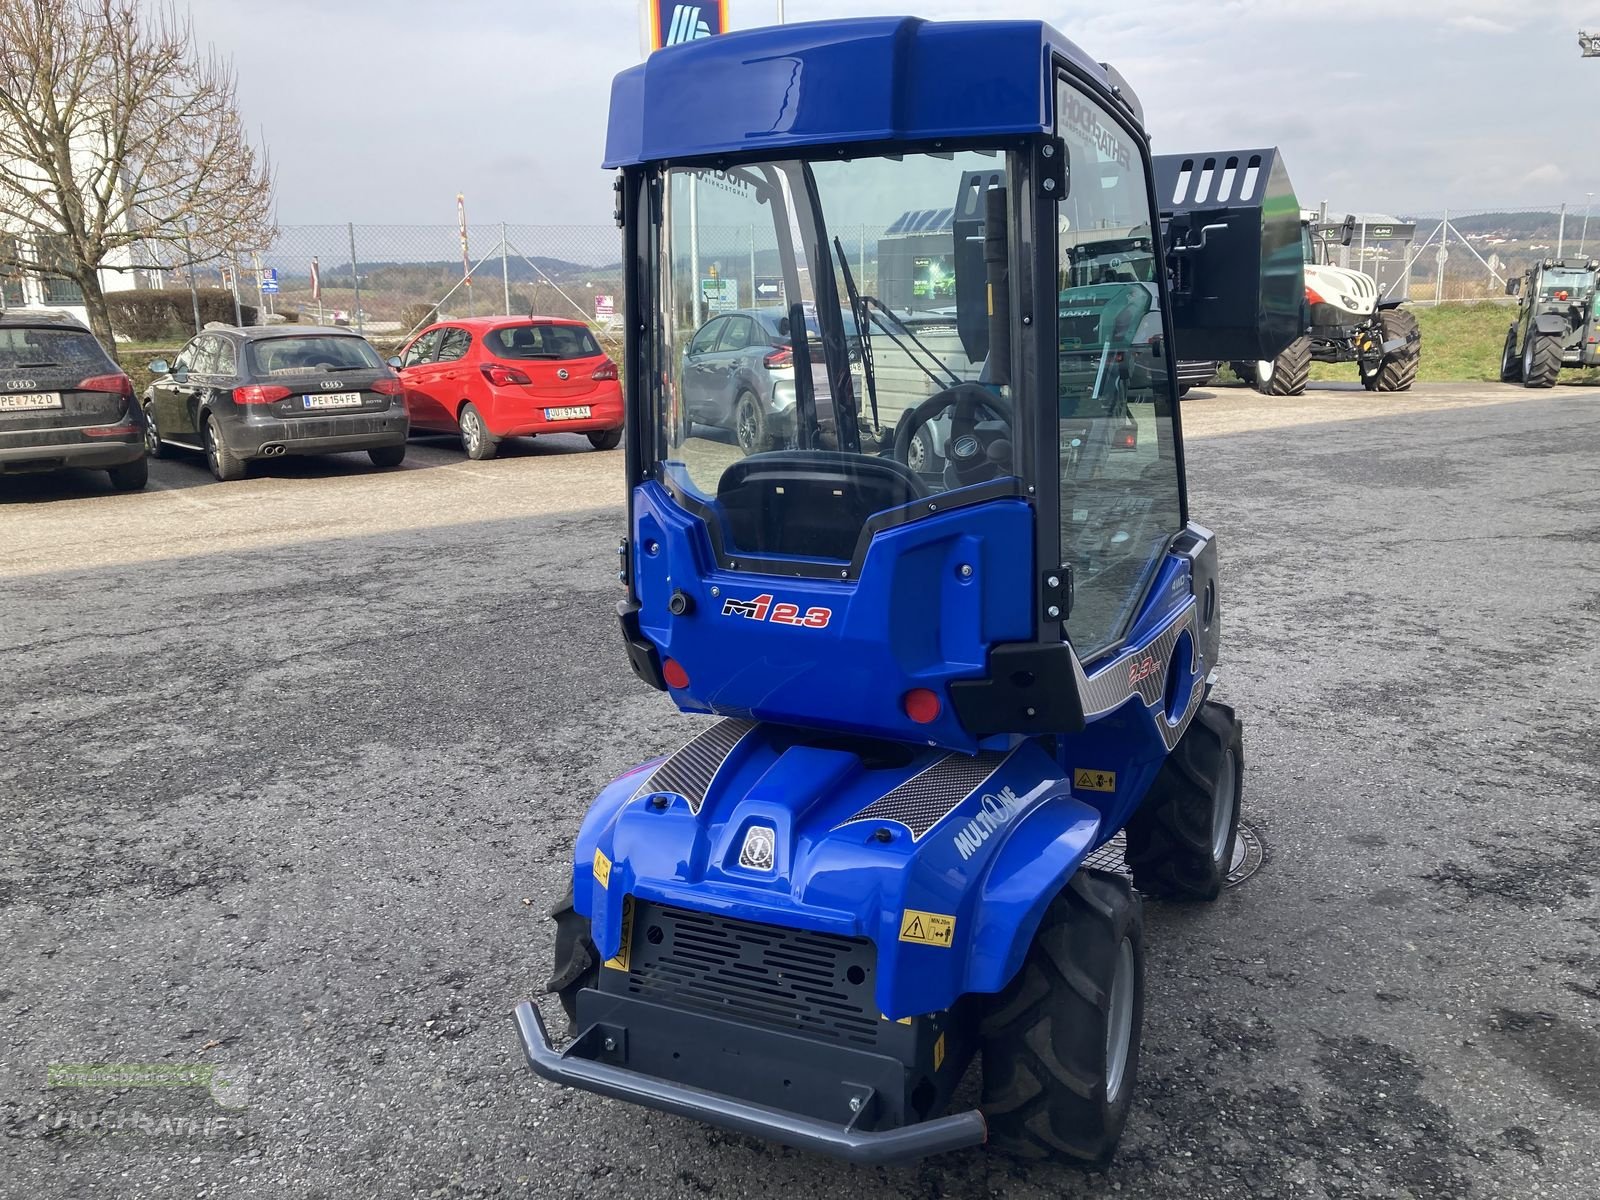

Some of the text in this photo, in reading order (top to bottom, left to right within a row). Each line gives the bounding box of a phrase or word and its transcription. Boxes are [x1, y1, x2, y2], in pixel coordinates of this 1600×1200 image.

[1, 396, 15, 406] PE
[312, 394, 357, 405] PE 154 FE
[769, 603, 832, 628] 2.3
